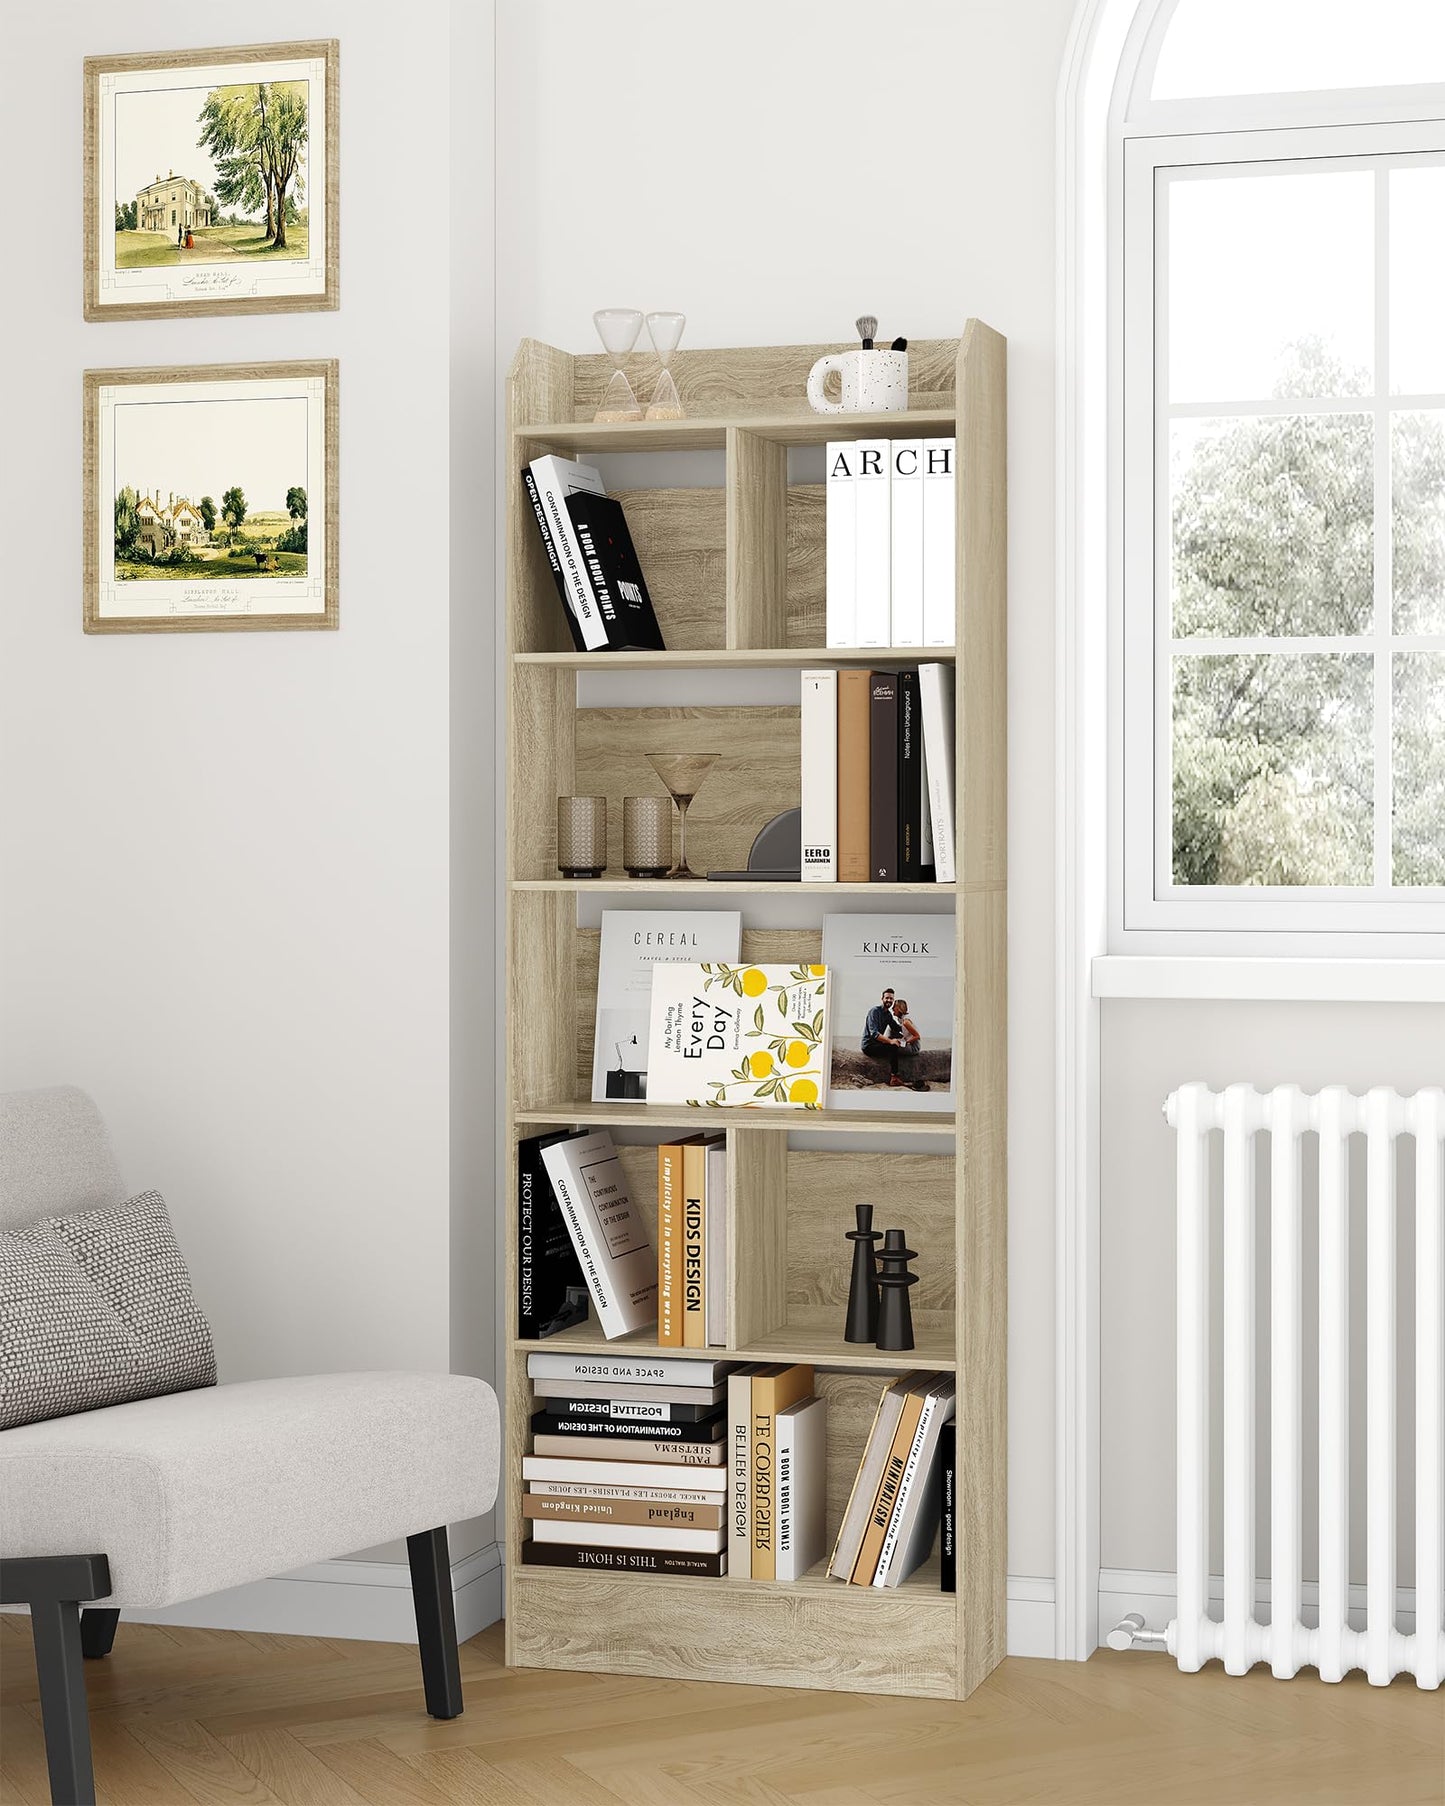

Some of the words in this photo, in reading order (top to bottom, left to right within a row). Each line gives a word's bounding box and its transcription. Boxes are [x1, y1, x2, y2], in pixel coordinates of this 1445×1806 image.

[525, 475, 539, 503] OPEN
[534, 503, 550, 541] DESIGN
[545, 541, 560, 572] NIGHT
[545, 491, 573, 559] CONTAMINATION
[580, 533, 597, 556] BOOK
[567, 559, 577, 570] OF
[587, 559, 606, 586] ABOUT
[571, 571, 582, 588] THE
[576, 588, 592, 619] DESIGN
[598, 589, 616, 620] POINTS
[815, 682, 818, 690] 1
[937, 818, 947, 864] PORTRAITS
[804, 849, 830, 858] EERO
[634, 932, 697, 945] CEREAL
[863, 942, 929, 954] KINFOLK
[664, 1006, 675, 1035] Darling
[674, 1002, 684, 1026] Thyme
[734, 1008, 742, 1033] Galloway
[683, 996, 711, 1058] Every
[706, 1006, 733, 1050] Day
[664, 1037, 673, 1049] My
[674, 1029, 682, 1053] Lemon
[662, 1157, 672, 1211] simplicity
[522, 1173, 532, 1233] PROTECT
[557, 1179, 586, 1247] CONTAMINATION
[664, 1214, 672, 1224] is
[686, 1198, 701, 1240] KIDS
[664, 1227, 672, 1237] in
[522, 1235, 532, 1265] OUR
[582, 1248, 591, 1260] OF
[586, 1259, 597, 1277] THE
[662, 1241, 672, 1298] everything
[686, 1245, 701, 1312] DESIGN
[522, 1267, 532, 1316] DESIGN
[592, 1277, 608, 1309] DESIGN
[664, 1301, 671, 1315] we
[912, 1408, 930, 1458] simplicity
[654, 1443, 712, 1454] SIETSEMA
[681, 1455, 710, 1464] PAUL
[909, 1461, 916, 1469] is
[905, 1473, 912, 1482] in
[548, 1485, 571, 1493] JOURS
[633, 1490, 649, 1498] LES
[873, 1455, 904, 1528] MINIMALISM
[541, 1501, 580, 1513] Kingdom
[583, 1504, 613, 1515] United
[648, 1507, 695, 1521] England
[888, 1486, 907, 1539] everything
[578, 1551, 613, 1565] HOME
[885, 1543, 891, 1556] we
[616, 1554, 626, 1566] IS
[629, 1555, 657, 1568] THIS
[686, 1560, 708, 1568] NATALIE
